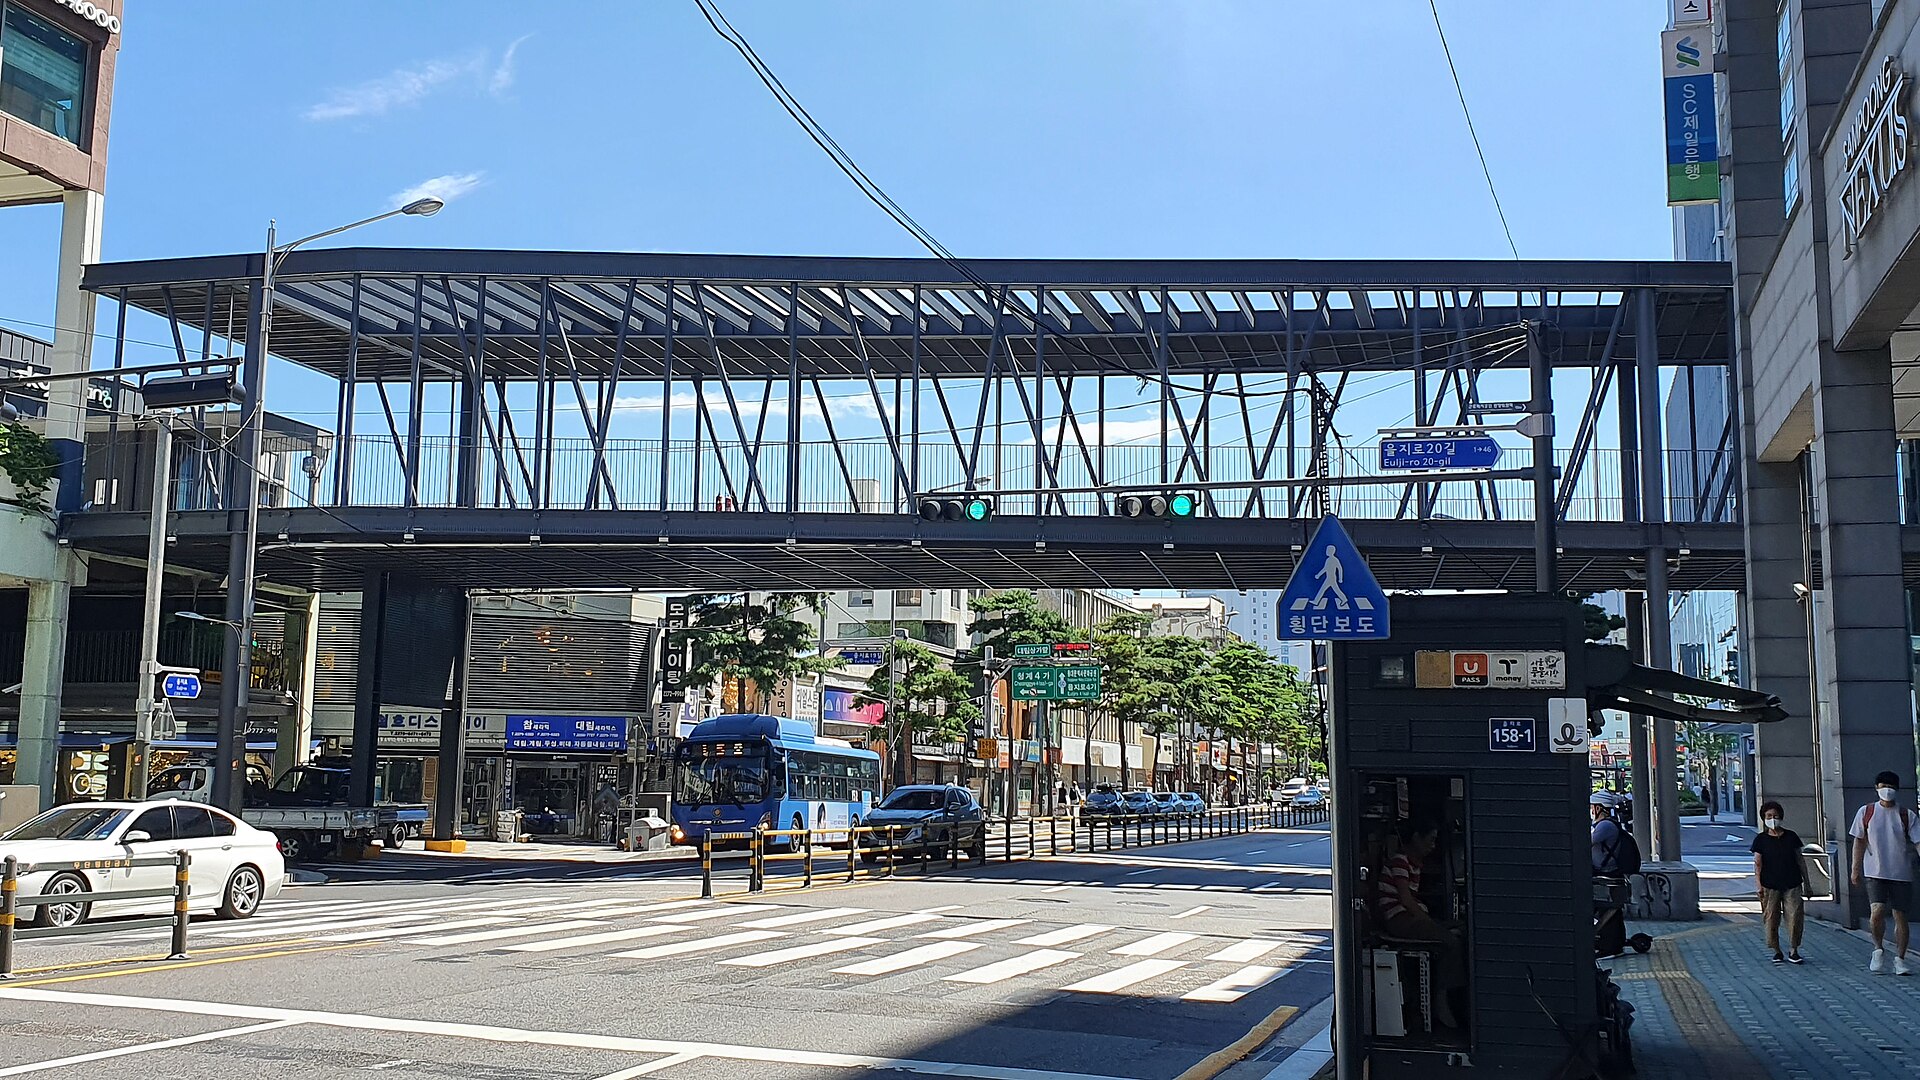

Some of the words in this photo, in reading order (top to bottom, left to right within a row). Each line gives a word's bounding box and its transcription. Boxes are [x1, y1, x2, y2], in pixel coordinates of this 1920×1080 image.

[1843, 55, 1891, 172] SAMPOONG
[1683, 83, 1700, 180] SC제일은행
[1839, 75, 1908, 260] NEXUS
[1384, 441, 1456, 456] 을지로20길
[1384, 458, 1420, 468] Eulji-ro
[1422, 457, 1451, 467] 20-gil
[1289, 615, 1375, 634] 횡단보도
[1493, 728, 1531, 743] 158-1
